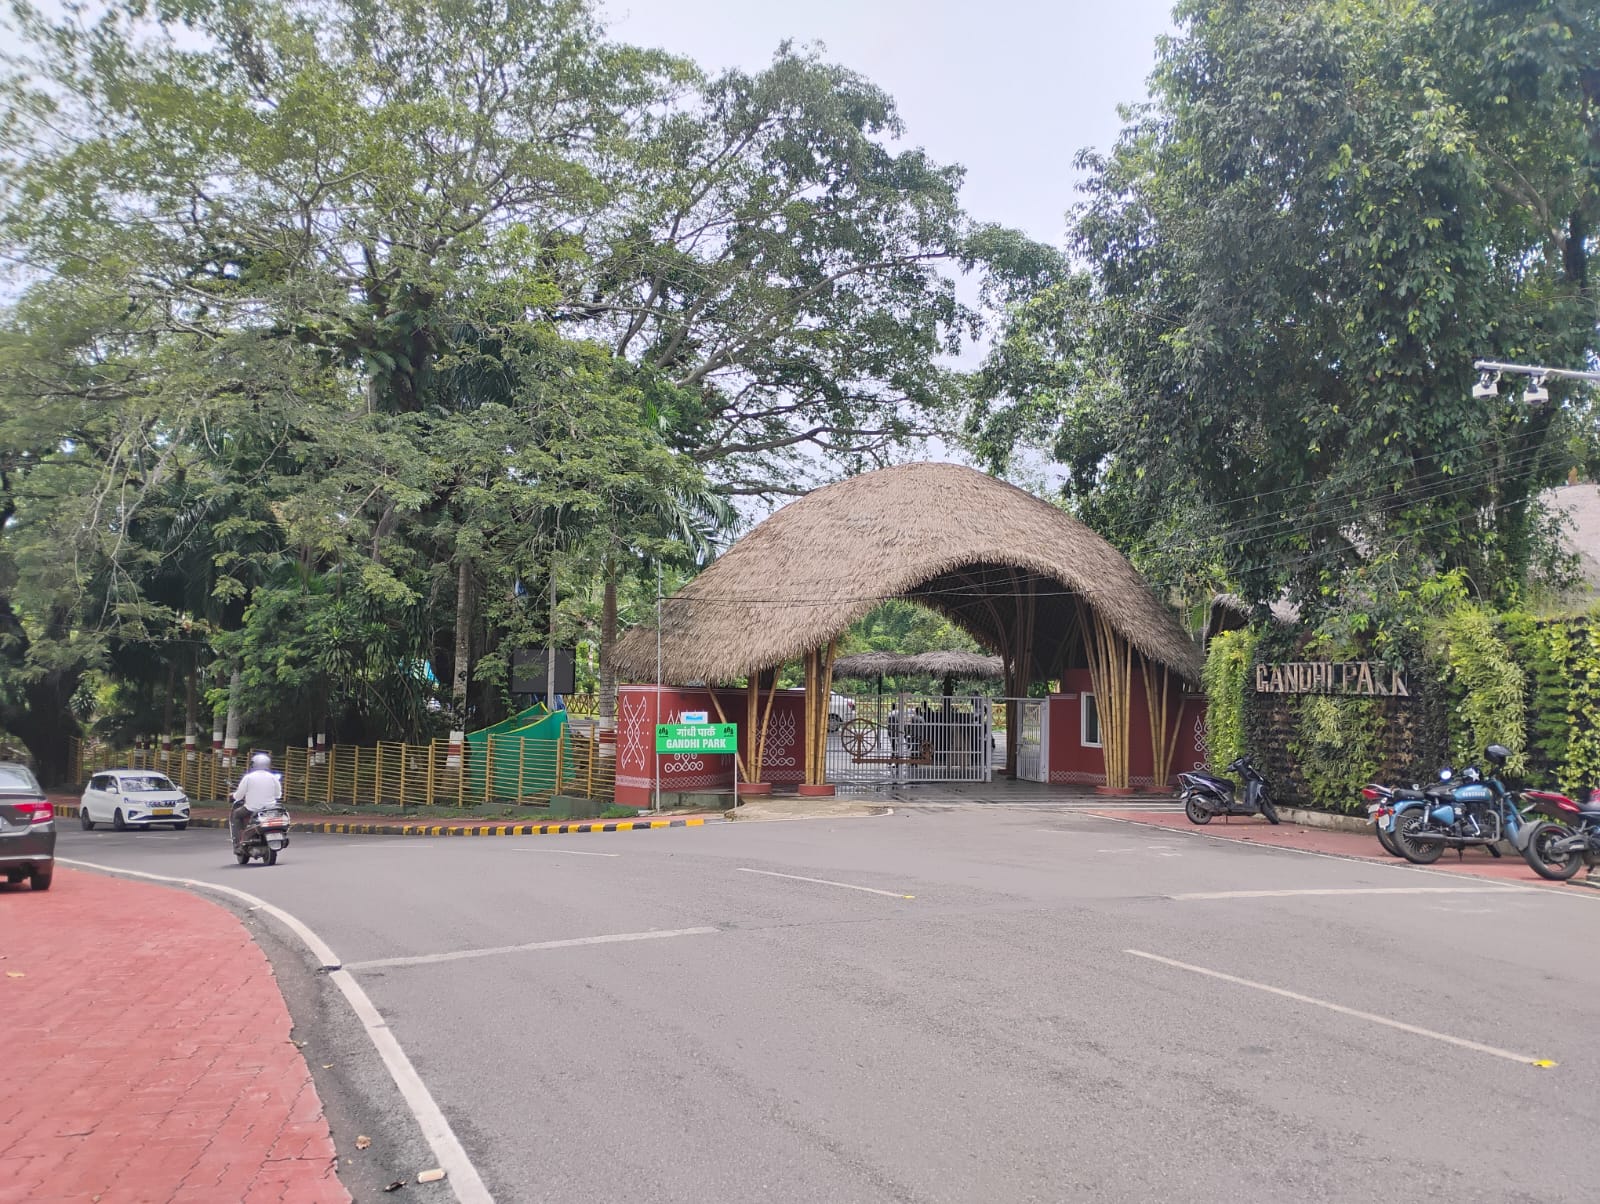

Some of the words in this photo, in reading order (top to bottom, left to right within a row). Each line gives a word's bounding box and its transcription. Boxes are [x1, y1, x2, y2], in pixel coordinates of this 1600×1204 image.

[1256, 662, 1333, 694] GANDHI
[676, 726, 697, 737] गांधी
[697, 726, 717, 737] पार्क
[666, 739, 700, 749] GANDHI
[702, 738, 726, 748] PARK
